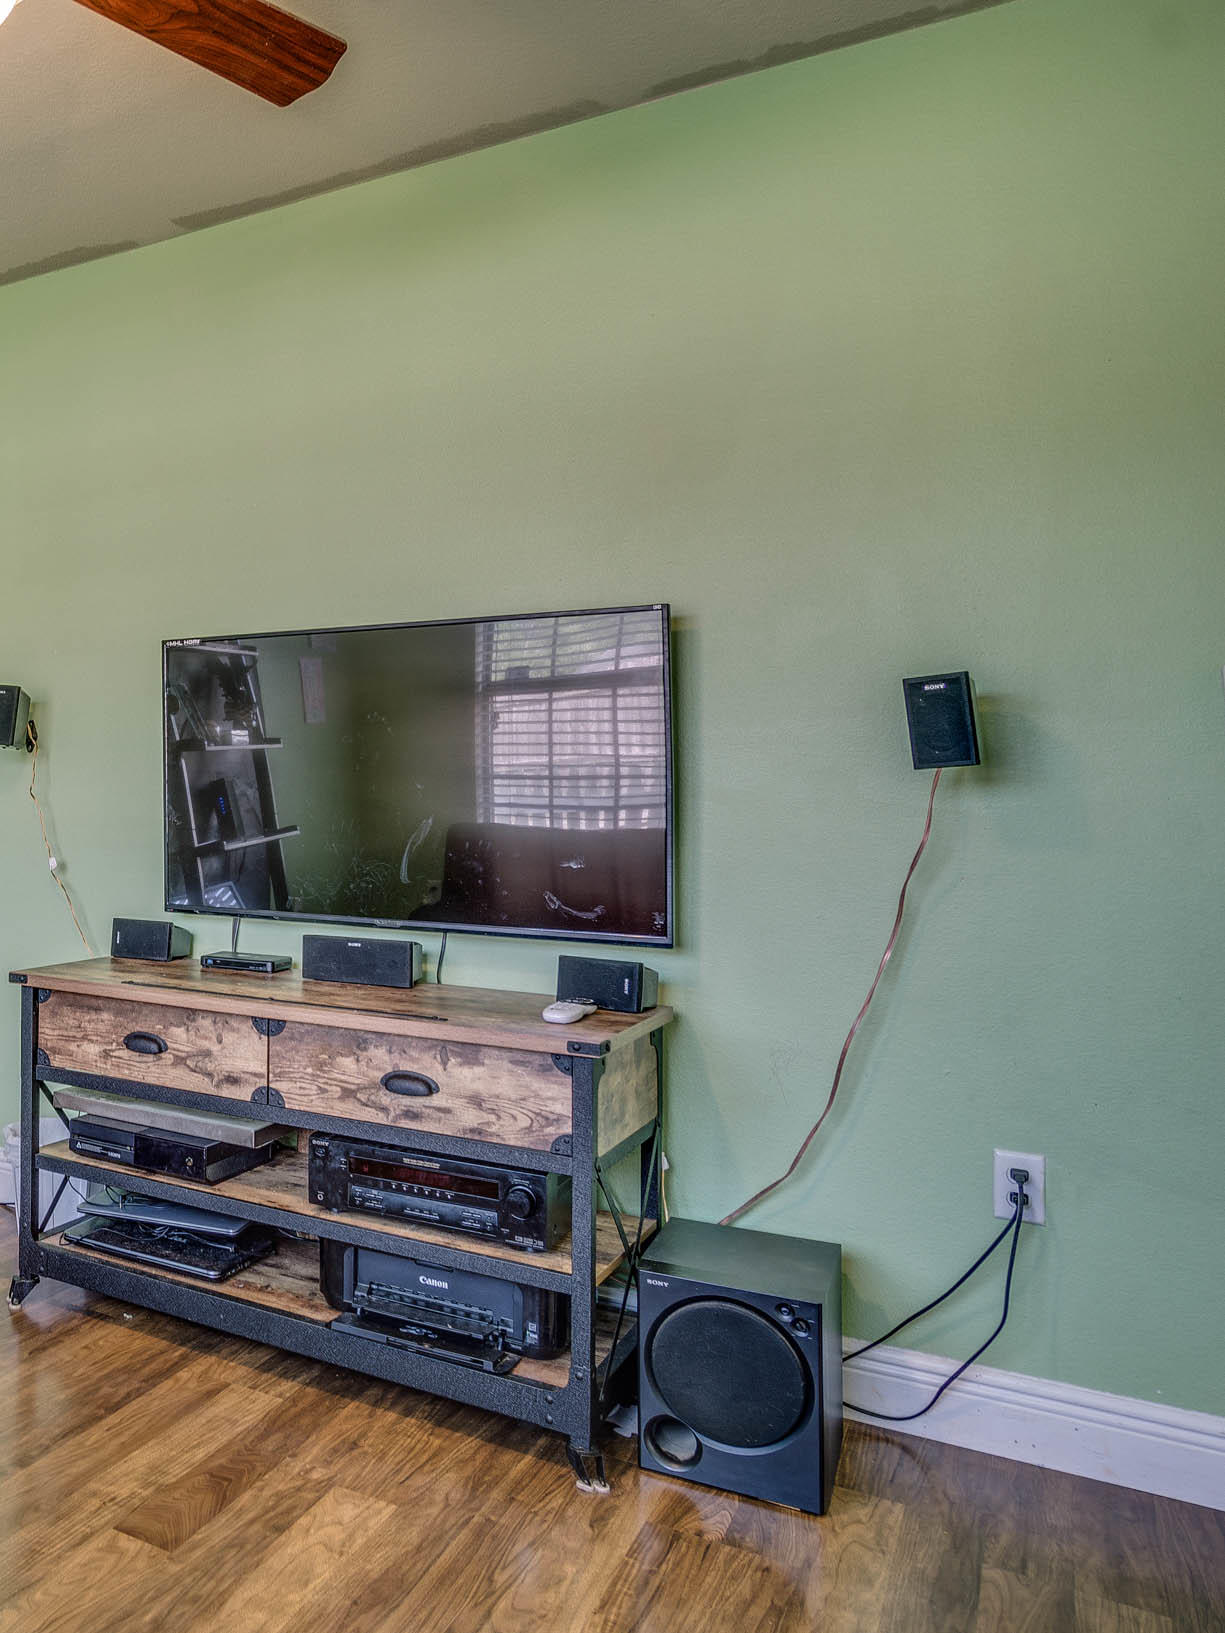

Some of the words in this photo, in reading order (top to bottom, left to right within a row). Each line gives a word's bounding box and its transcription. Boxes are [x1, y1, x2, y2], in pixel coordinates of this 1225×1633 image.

[923, 682, 947, 691] SONY
[311, 1139, 330, 1147] SONY
[418, 1275, 449, 1290] Canon
[646, 1278, 669, 1288] SONY
